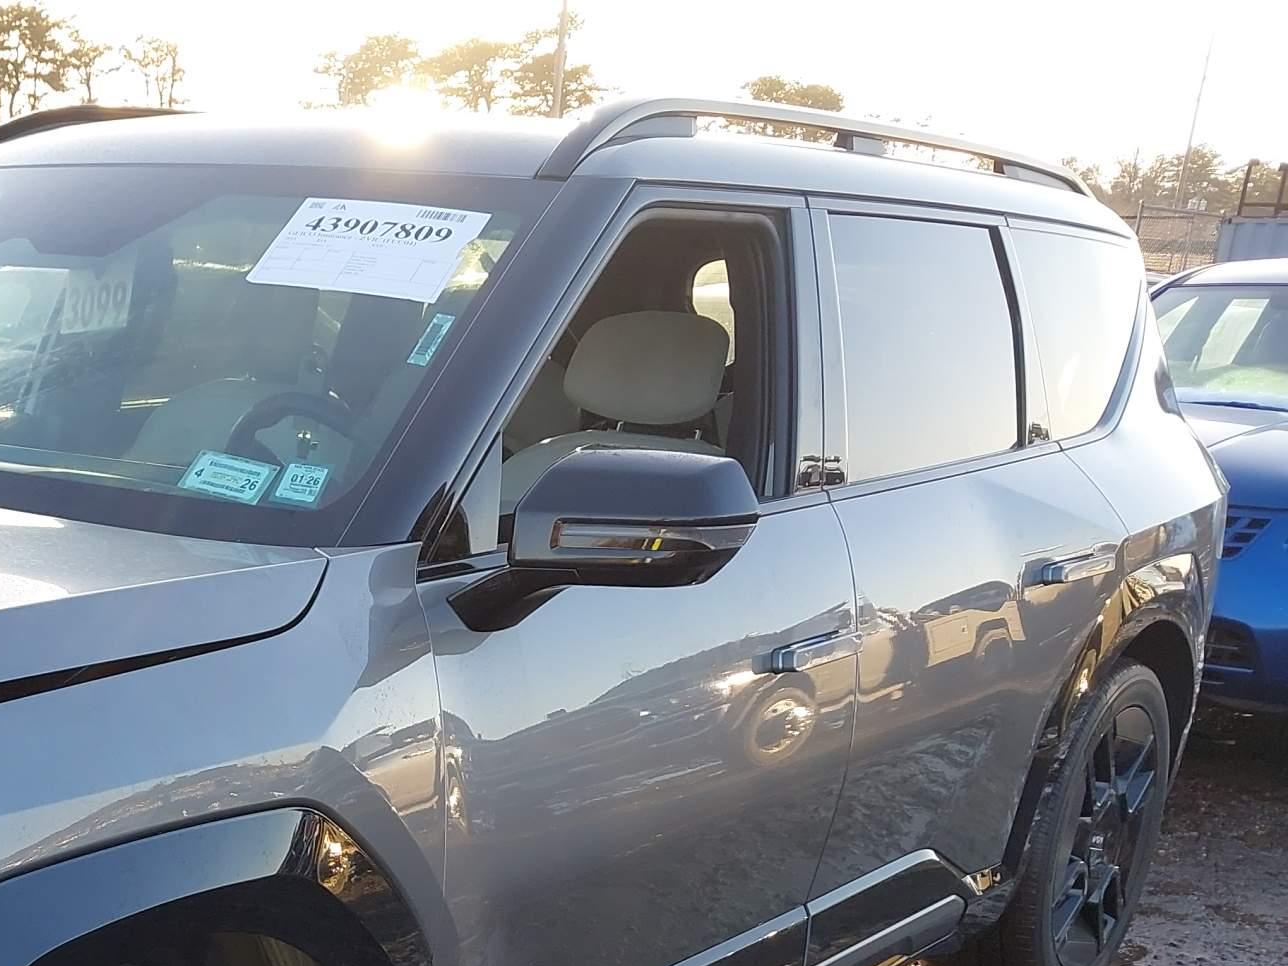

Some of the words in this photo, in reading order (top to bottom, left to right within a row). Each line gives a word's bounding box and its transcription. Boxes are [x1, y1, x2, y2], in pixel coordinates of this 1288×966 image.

[305, 215, 453, 243] 43907809
[194, 468, 205, 478] 4
[239, 478, 259, 491] 26
